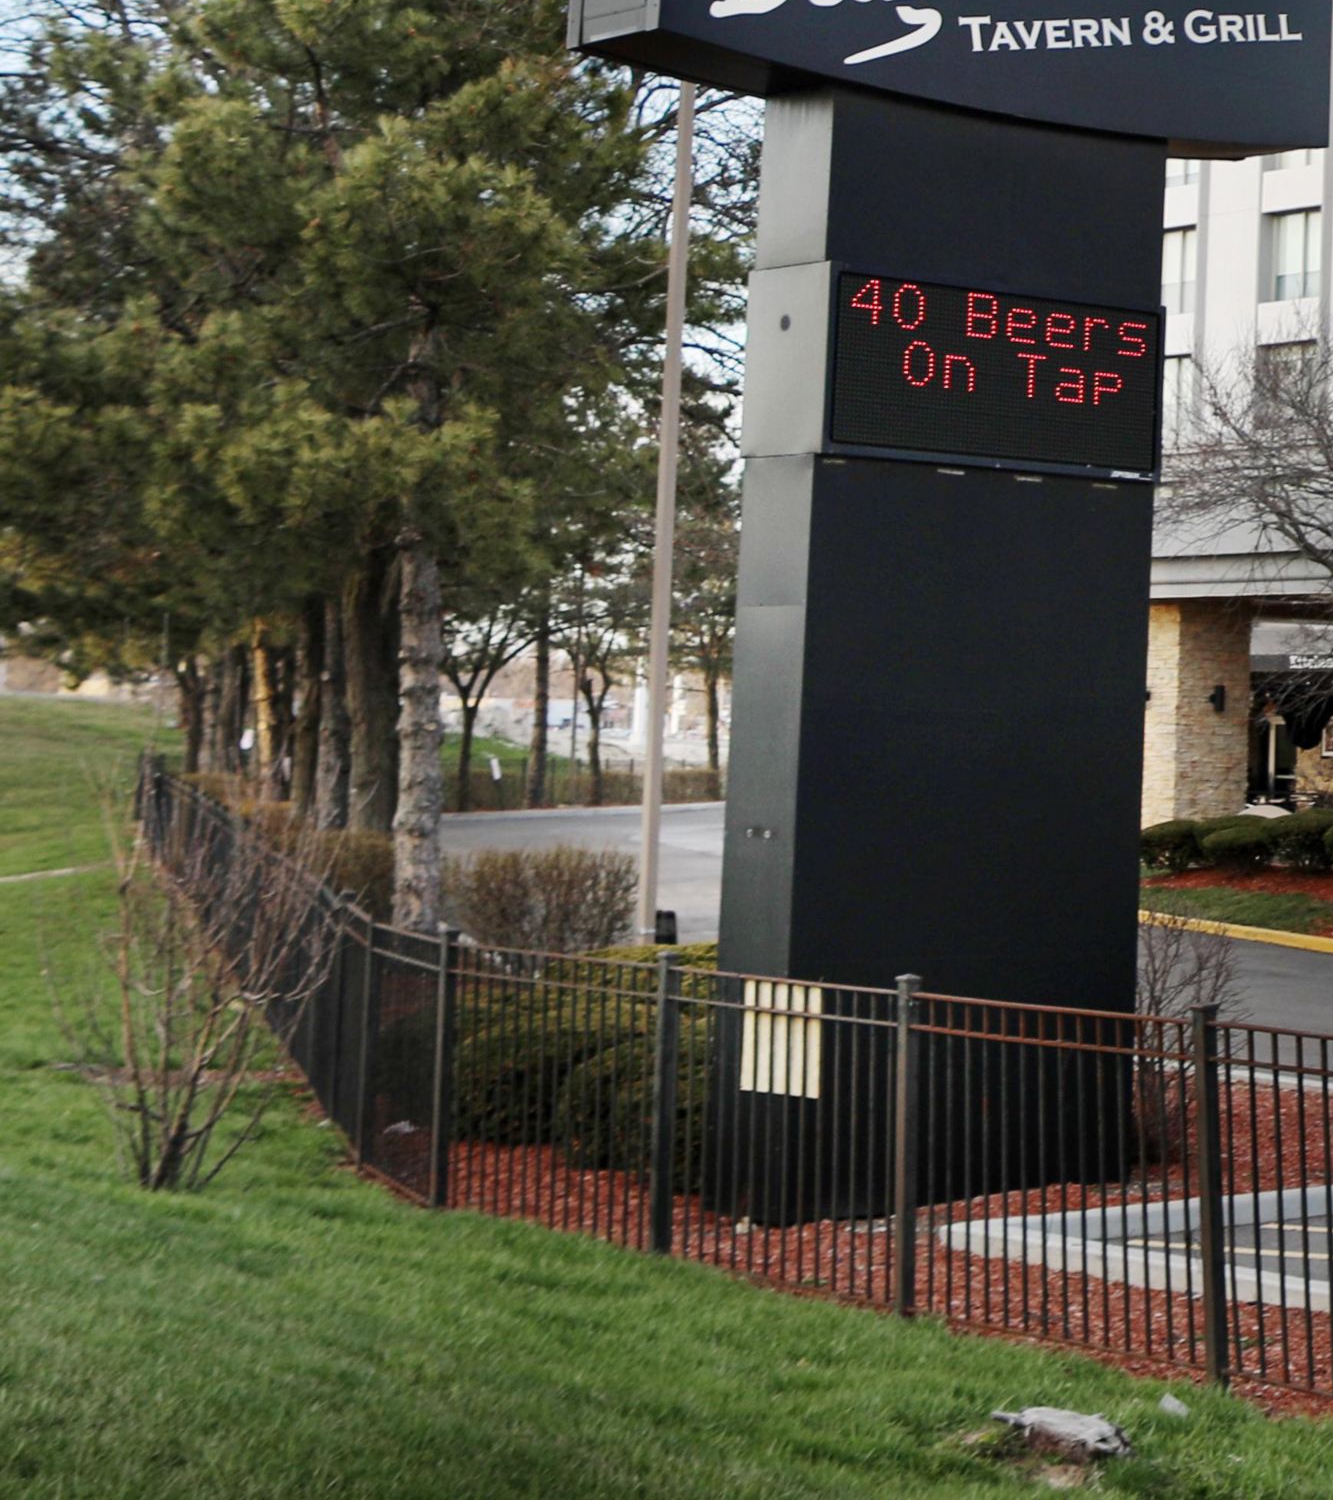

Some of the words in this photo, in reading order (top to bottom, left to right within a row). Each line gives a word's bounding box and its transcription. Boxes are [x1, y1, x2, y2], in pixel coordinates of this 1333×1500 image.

[959, 15, 1131, 53] TAVERN
[1142, 12, 1176, 45] &
[1183, 9, 1303, 43] GRILL
[850, 279, 926, 330] 40
[966, 291, 1147, 357] Beers
[902, 340, 975, 393] On
[1017, 352, 1124, 405] Tap
